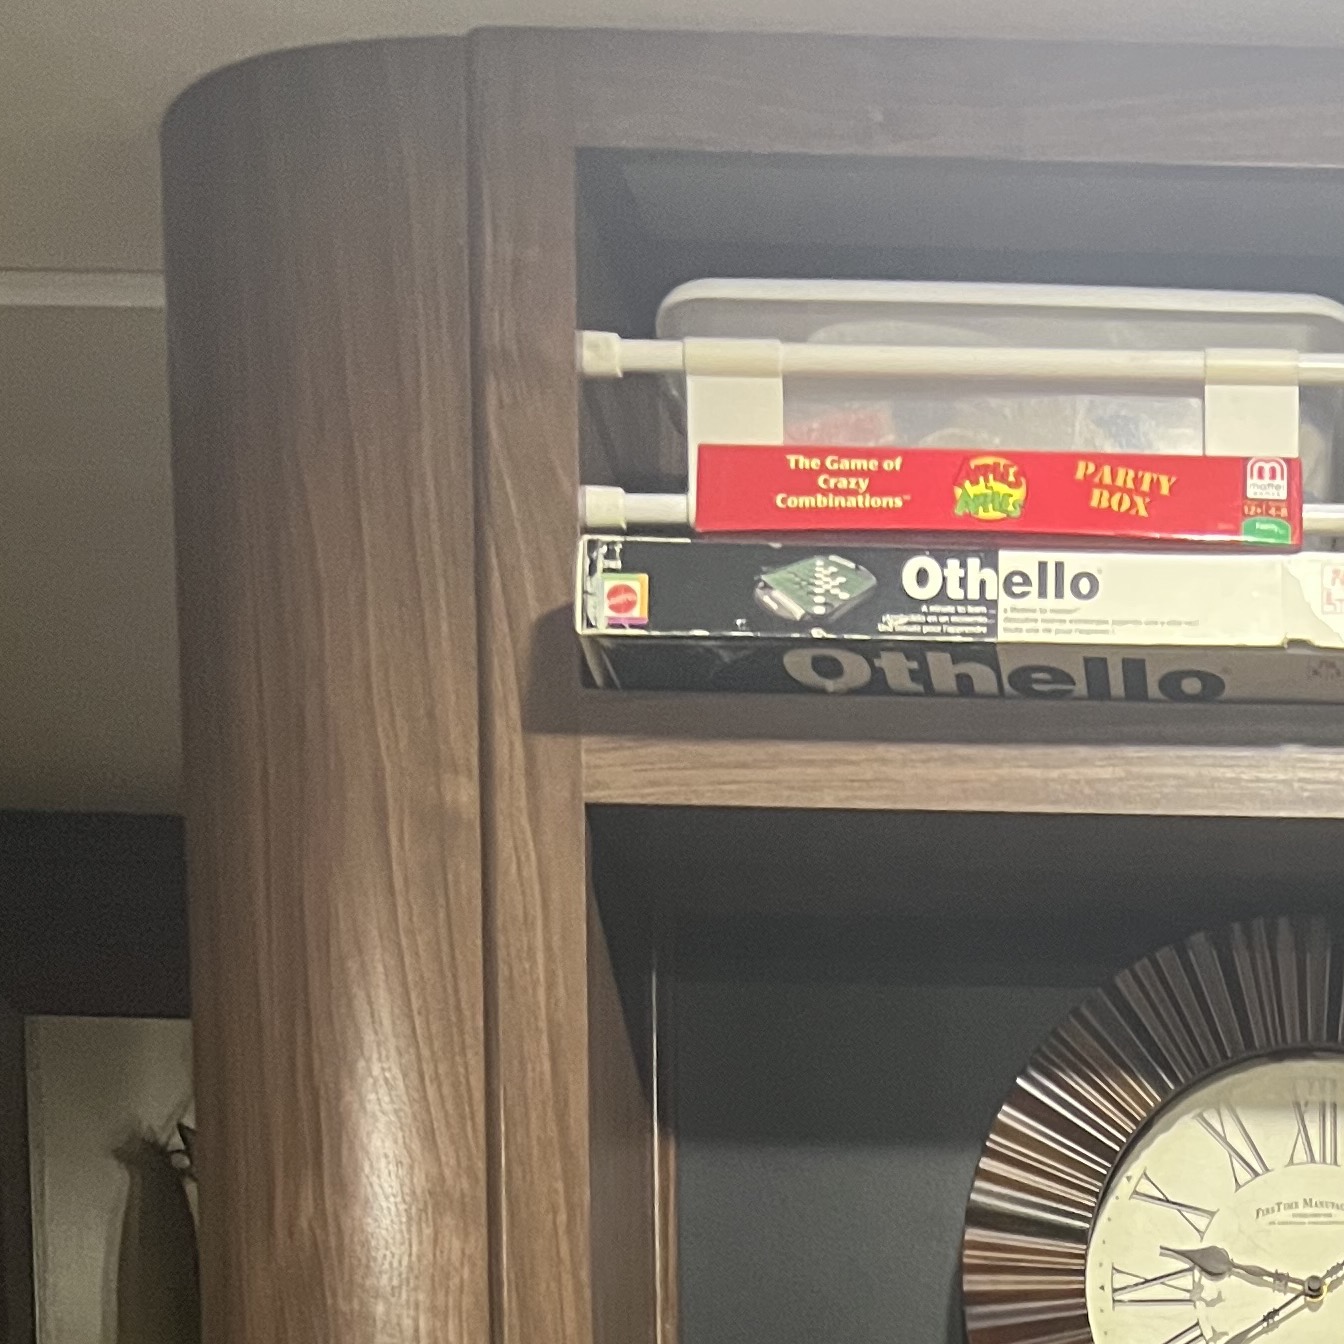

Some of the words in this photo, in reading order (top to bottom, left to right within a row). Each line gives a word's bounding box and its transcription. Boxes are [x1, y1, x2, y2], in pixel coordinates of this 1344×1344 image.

[785, 454, 821, 471] The
[825, 455, 879, 471] Game
[882, 455, 903, 471] of
[1074, 460, 1178, 496] PARTY
[817, 474, 870, 493] Crazy
[1089, 487, 1152, 518] BOX
[901, 554, 1100, 601] Othello
[783, 647, 1226, 699] Othello
